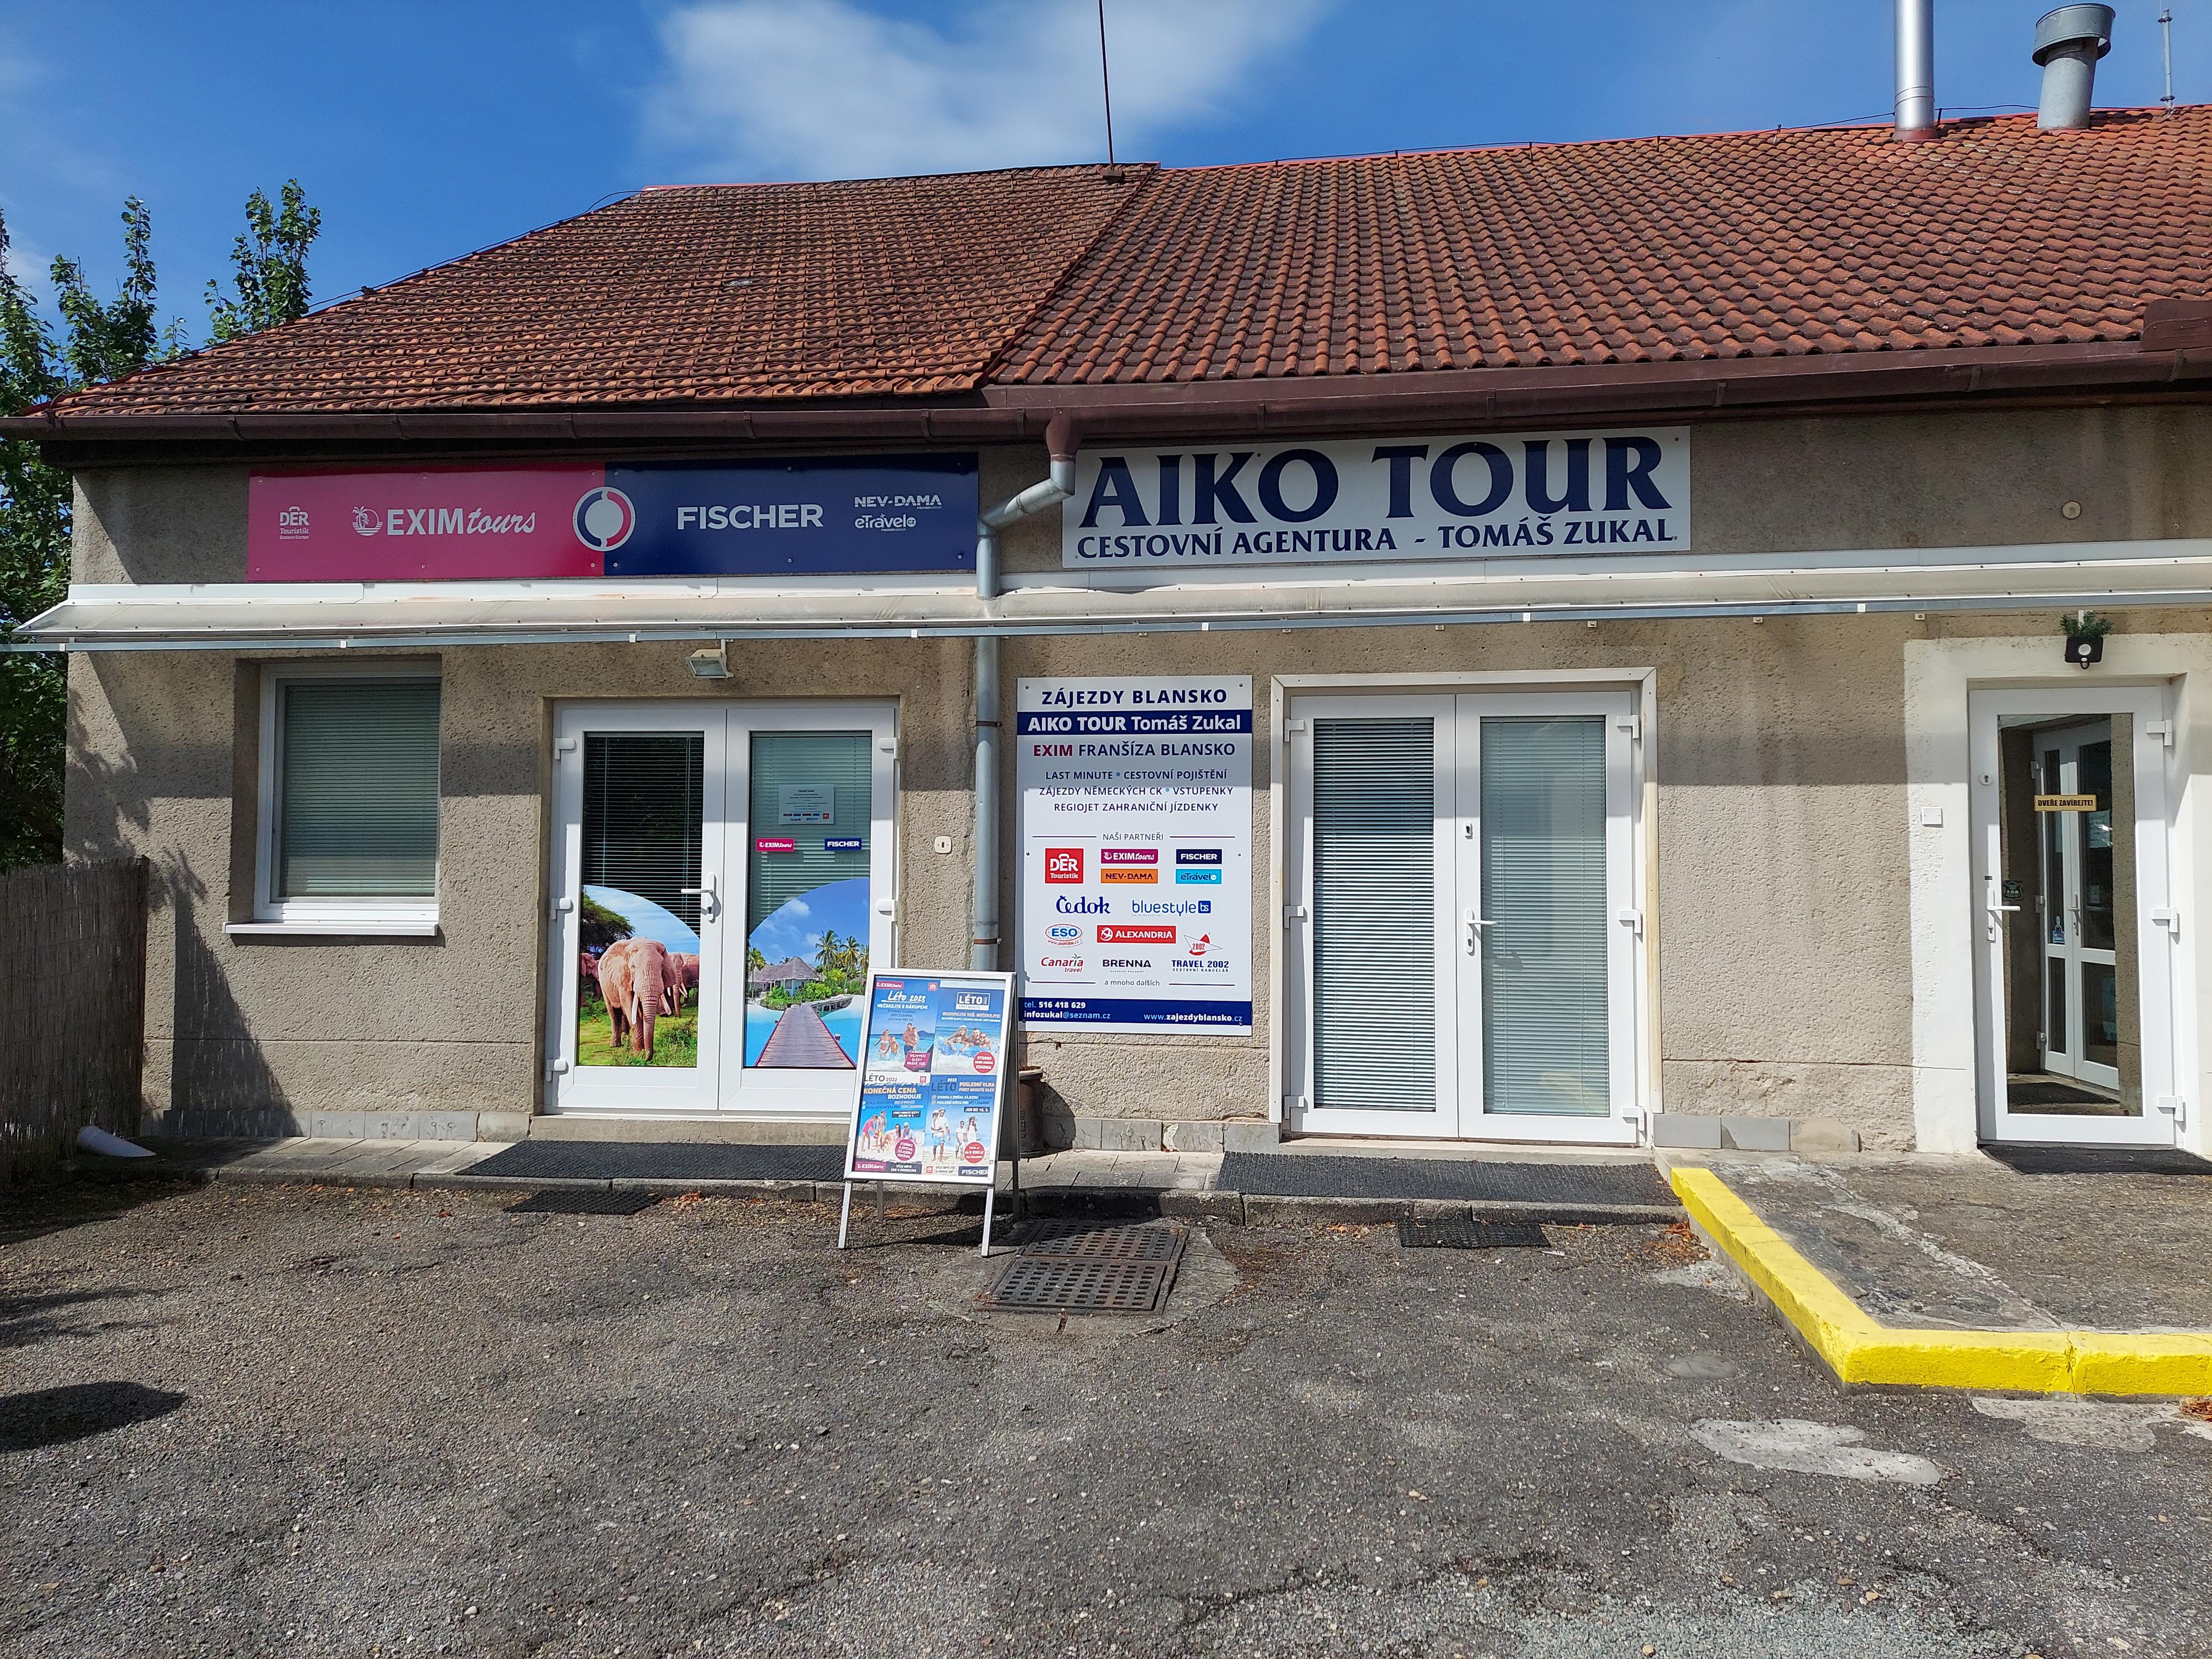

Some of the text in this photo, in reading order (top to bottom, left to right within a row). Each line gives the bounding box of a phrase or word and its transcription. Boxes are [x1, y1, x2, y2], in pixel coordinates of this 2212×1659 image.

[1078, 435, 1673, 528] AIKO TOUR
[854, 495, 942, 508] NEV-DAMA
[280, 512, 309, 526] DER
[387, 507, 536, 535] EXIMtours
[677, 504, 824, 530] FISCHER
[1077, 525, 1223, 559] CESTOVNÍ
[1231, 527, 1398, 554] AGENTURA
[1441, 514, 1554, 549] TOMÁŠ
[1564, 518, 1674, 544] ZUKAL
[1041, 687, 1227, 708] ZÁJEZDY BLANSKO
[1027, 714, 1240, 732] AIKO TOUR Tomáš Zukal
[1033, 740, 1236, 757] EXIM FRANŠÍZA BLANSKO
[1045, 769, 1228, 780] LAST MINUTE CESTOVNÍ POJIŠTĚNÍ
[1039, 785, 1233, 796] ZÁJEZDY NĚMECKÝCH CK VSTUPENKY
[1054, 801, 1218, 813] REGIOJET ZAHRANIČNÍ JÍZDENKY
[1103, 832, 1164, 841] NAŠI PARTNEŘI
[1050, 858, 1079, 871] DER
[1056, 895, 1111, 915] Čedok
[1132, 899, 1196, 917] bluestyle
[1051, 928, 1078, 937] ESO
[1115, 930, 1173, 938] ALEXANDRIA
[1041, 957, 1084, 967] Canaria
[1102, 959, 1152, 967] BRENNA
[1171, 959, 1204, 968] TRAVEL
[888, 990, 926, 1003] Léto 2023
[958, 993, 983, 1004] LÉTO
[1024, 1010, 1111, 1019] infozukal@seznam.cz
[1144, 1013, 1243, 1022] www.zajezdyblansko.cz
[864, 1073, 885, 1082] LÉTO
[931, 1079, 957, 1092] LÉTO
